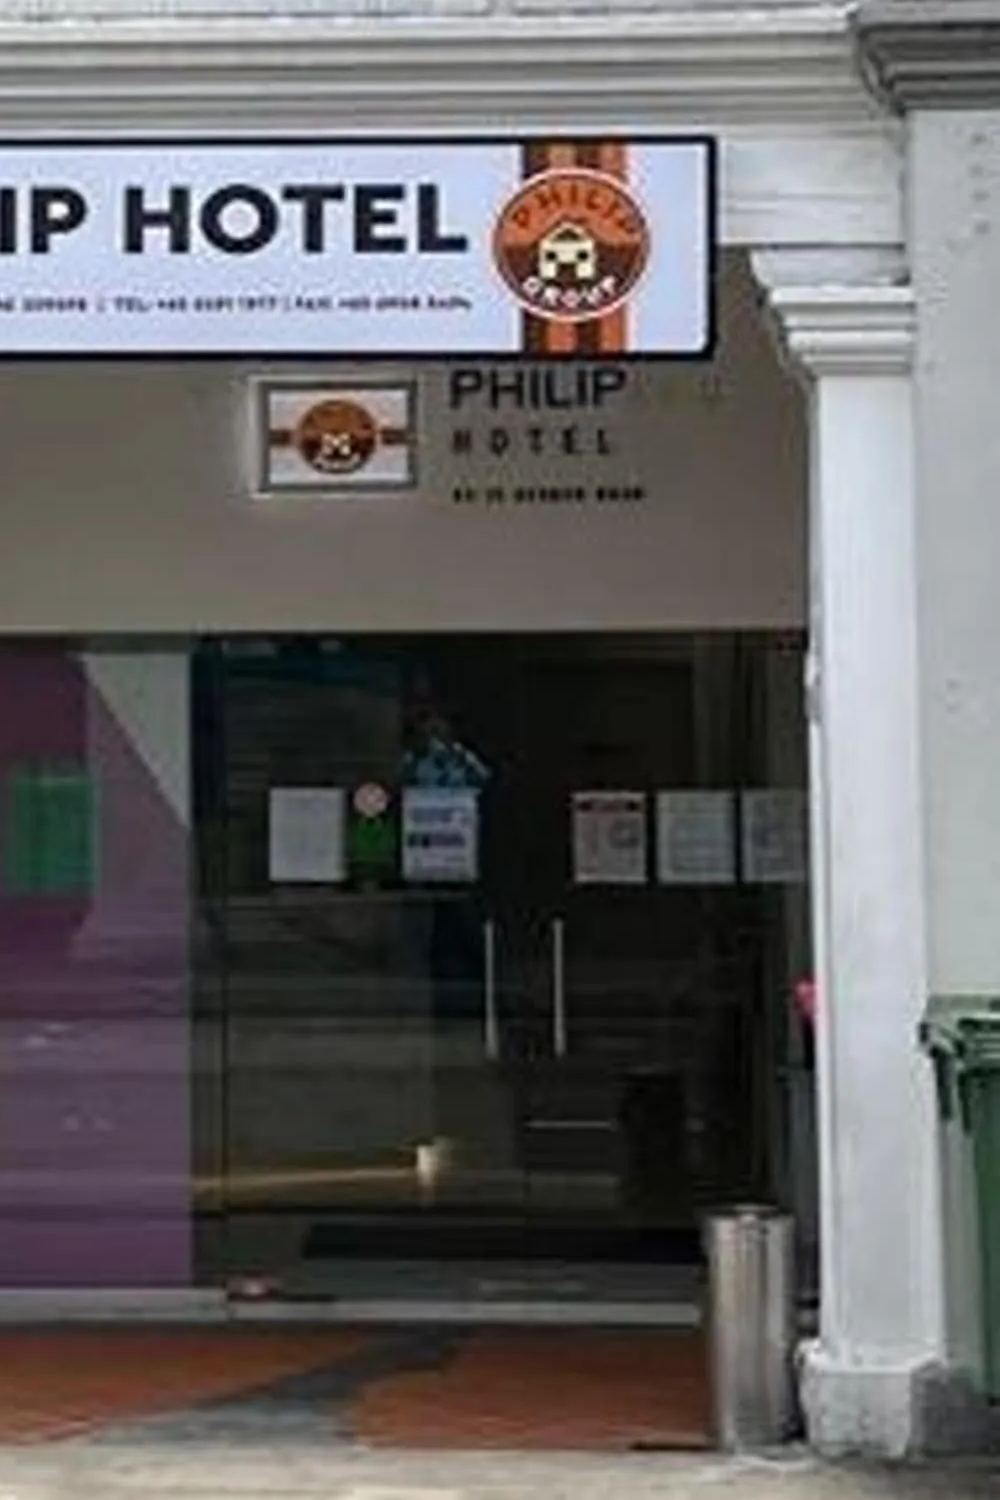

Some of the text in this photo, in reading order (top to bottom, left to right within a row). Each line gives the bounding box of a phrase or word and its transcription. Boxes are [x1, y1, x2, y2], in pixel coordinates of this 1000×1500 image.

[122, 183, 469, 254] HOTEL
[449, 368, 628, 410] PHILIP
[452, 426, 614, 457] HOTEL
